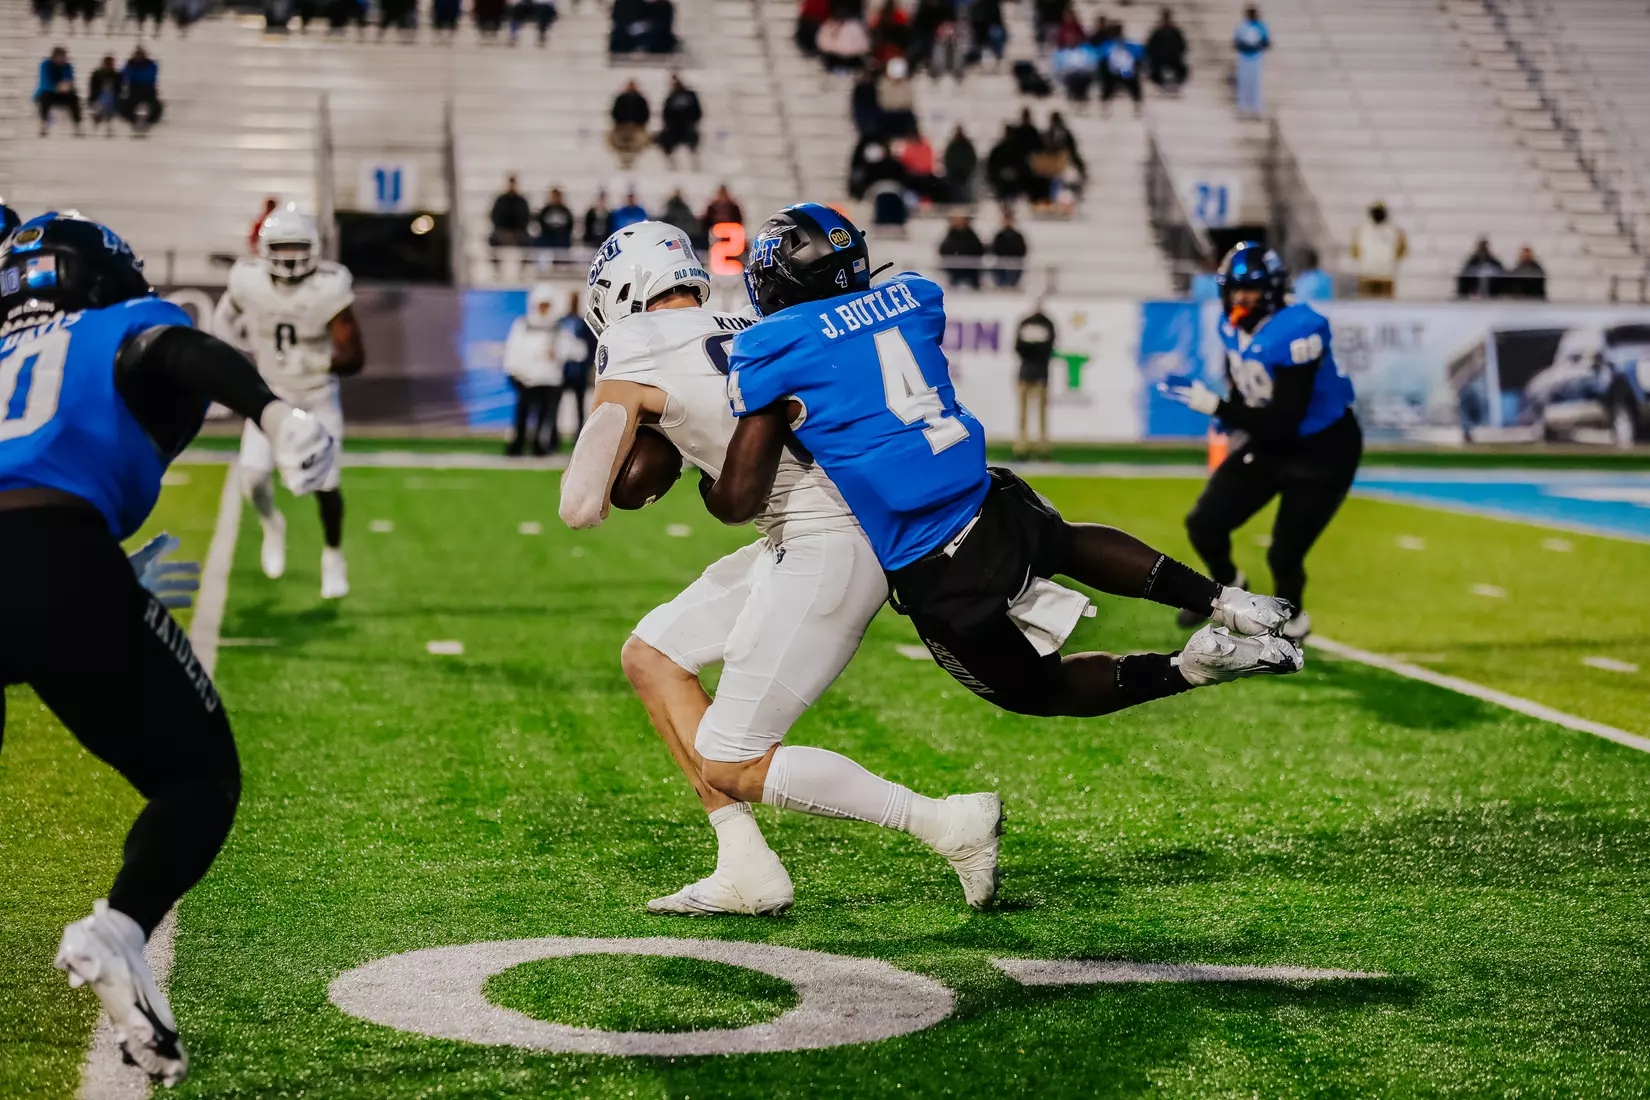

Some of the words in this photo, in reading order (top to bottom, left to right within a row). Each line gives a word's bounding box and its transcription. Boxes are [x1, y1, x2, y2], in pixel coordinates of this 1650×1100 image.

[711, 221, 745, 275] 2
[674, 269, 688, 281] OLD
[834, 268, 848, 288] 4
[727, 370, 747, 413] 4
[873, 326, 970, 456] 4
[144, 598, 218, 713] RAIDERS
